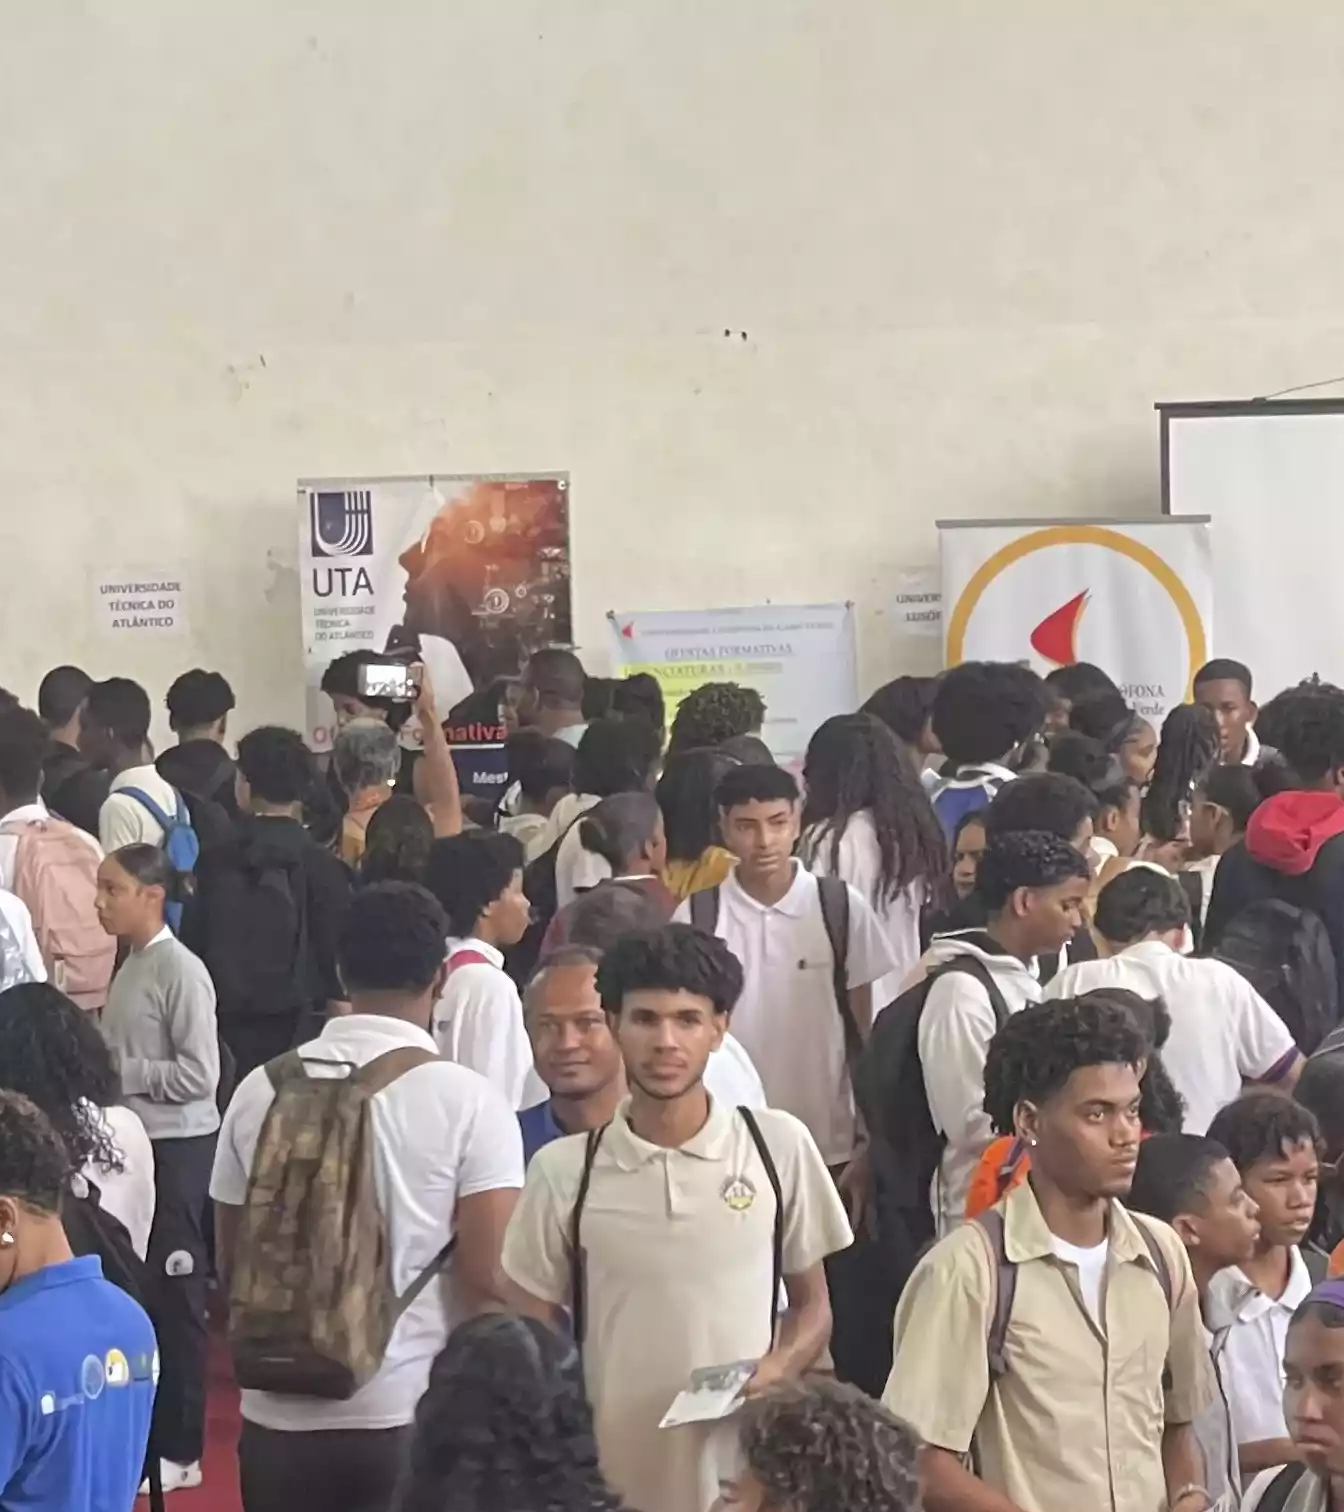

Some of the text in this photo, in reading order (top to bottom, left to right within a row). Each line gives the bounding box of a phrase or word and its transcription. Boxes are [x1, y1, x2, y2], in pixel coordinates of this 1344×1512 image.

[100, 582, 181, 594] UNIVERSIDADE
[313, 567, 374, 597] UTA
[109, 599, 174, 611] TÉCNICA DO
[112, 616, 173, 628] ATLÂNTICO
